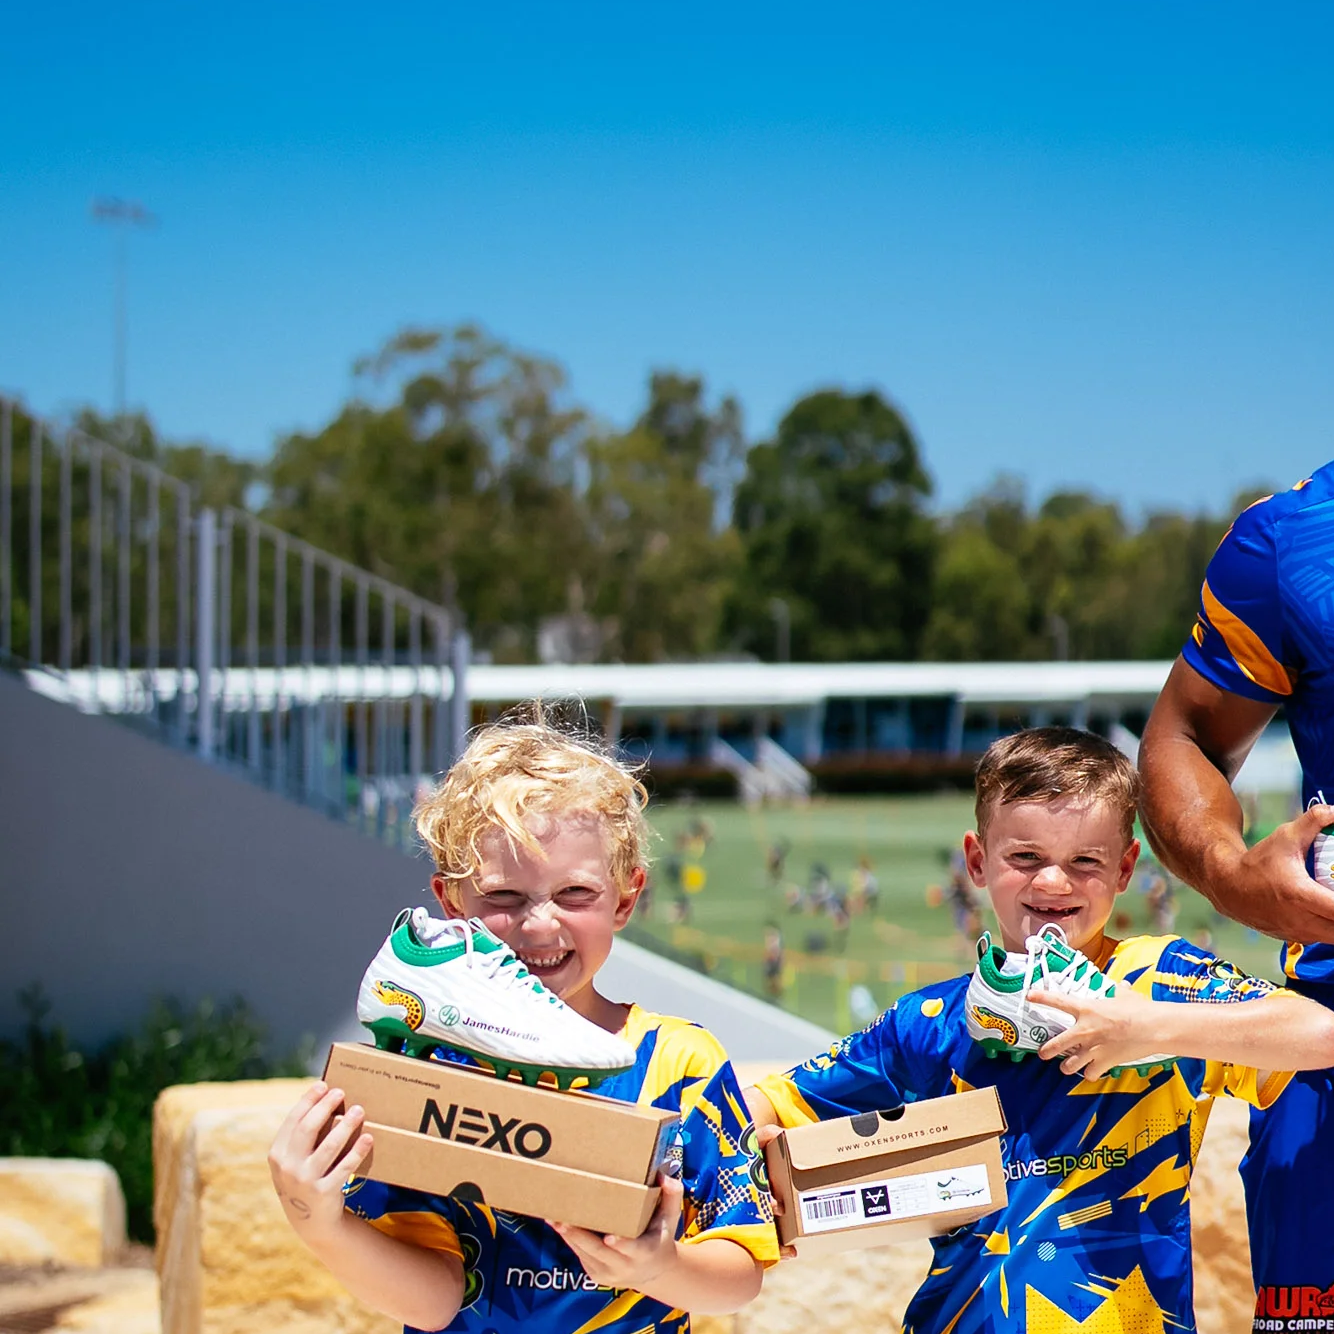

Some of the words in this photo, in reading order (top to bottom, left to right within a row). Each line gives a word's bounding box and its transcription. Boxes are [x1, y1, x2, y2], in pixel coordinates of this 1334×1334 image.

[462, 1016, 541, 1043] JamesHardie
[418, 1098, 552, 1159] NEXO
[836, 1125, 949, 1153] WWW.OXENSPORTS.COM
